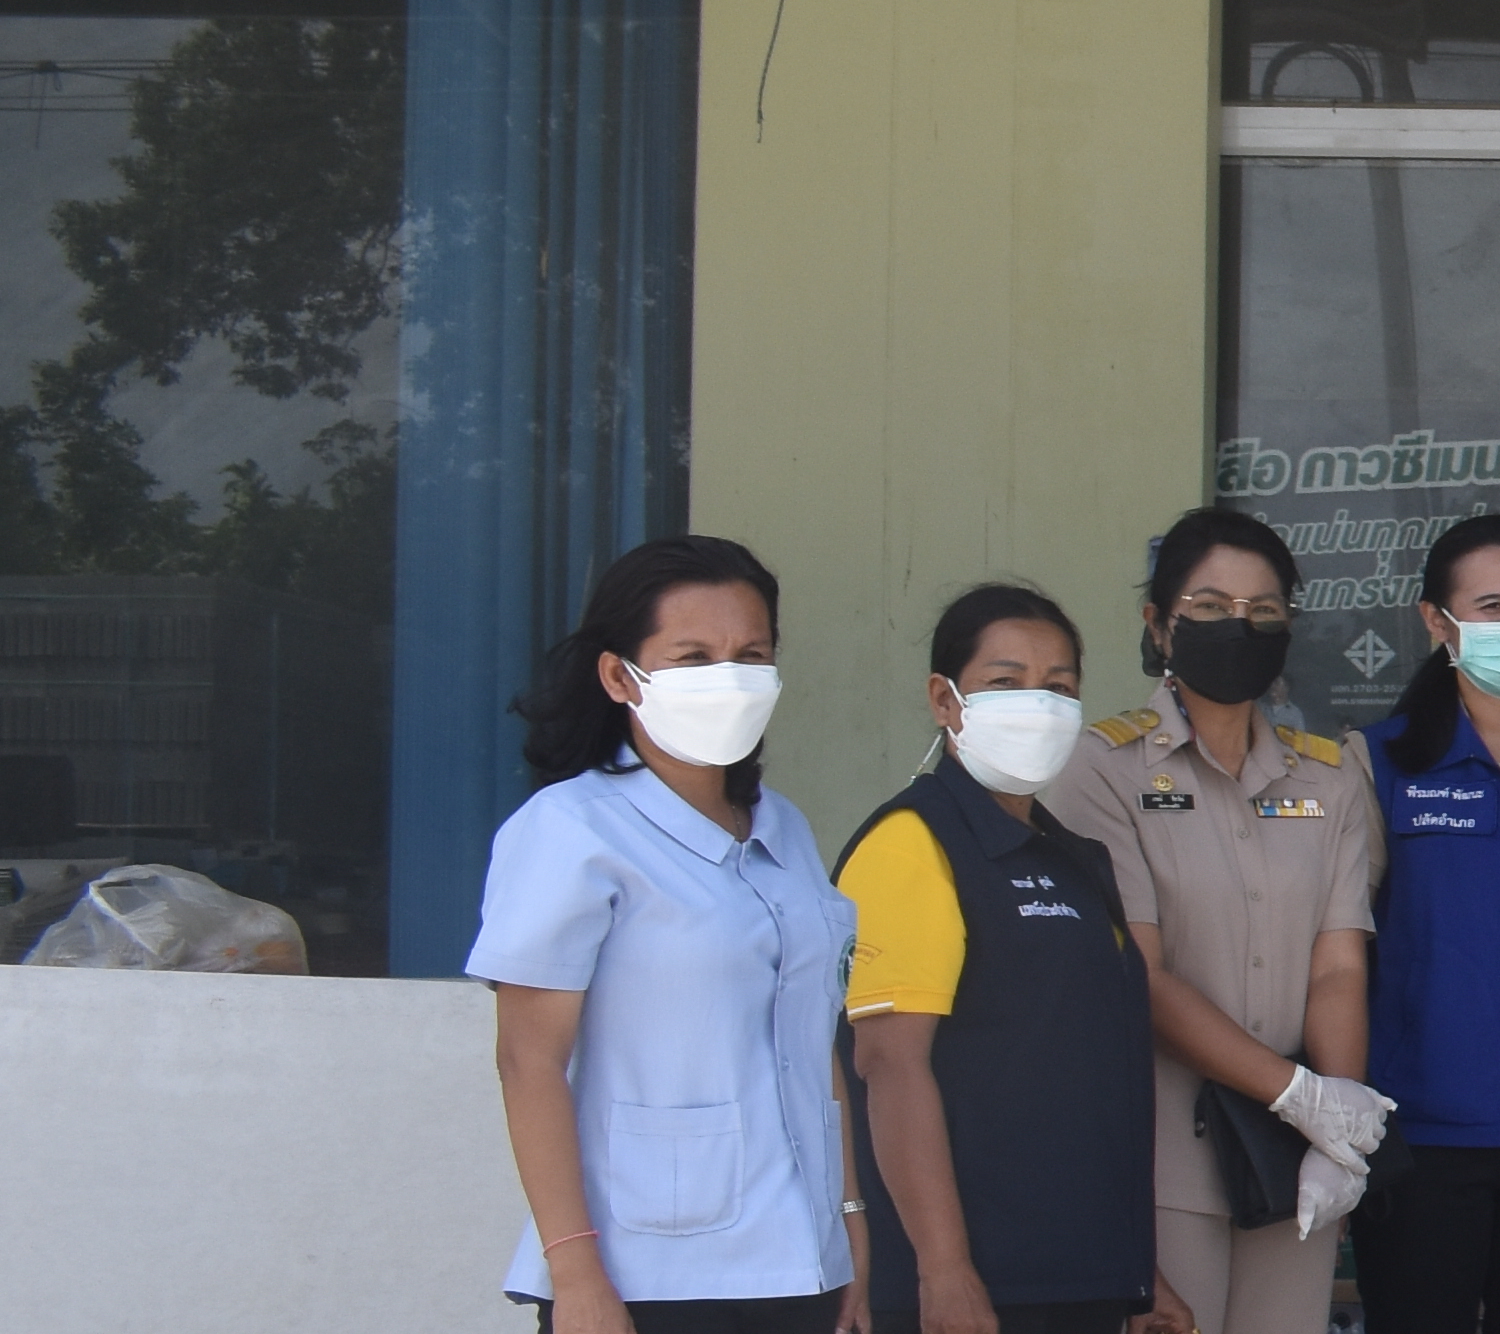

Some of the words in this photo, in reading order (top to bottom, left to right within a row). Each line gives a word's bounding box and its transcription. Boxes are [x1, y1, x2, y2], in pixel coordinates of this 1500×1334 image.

[1216, 436, 1292, 498] สือ
[1412, 812, 1476, 829] ปลัดอำเภอ
